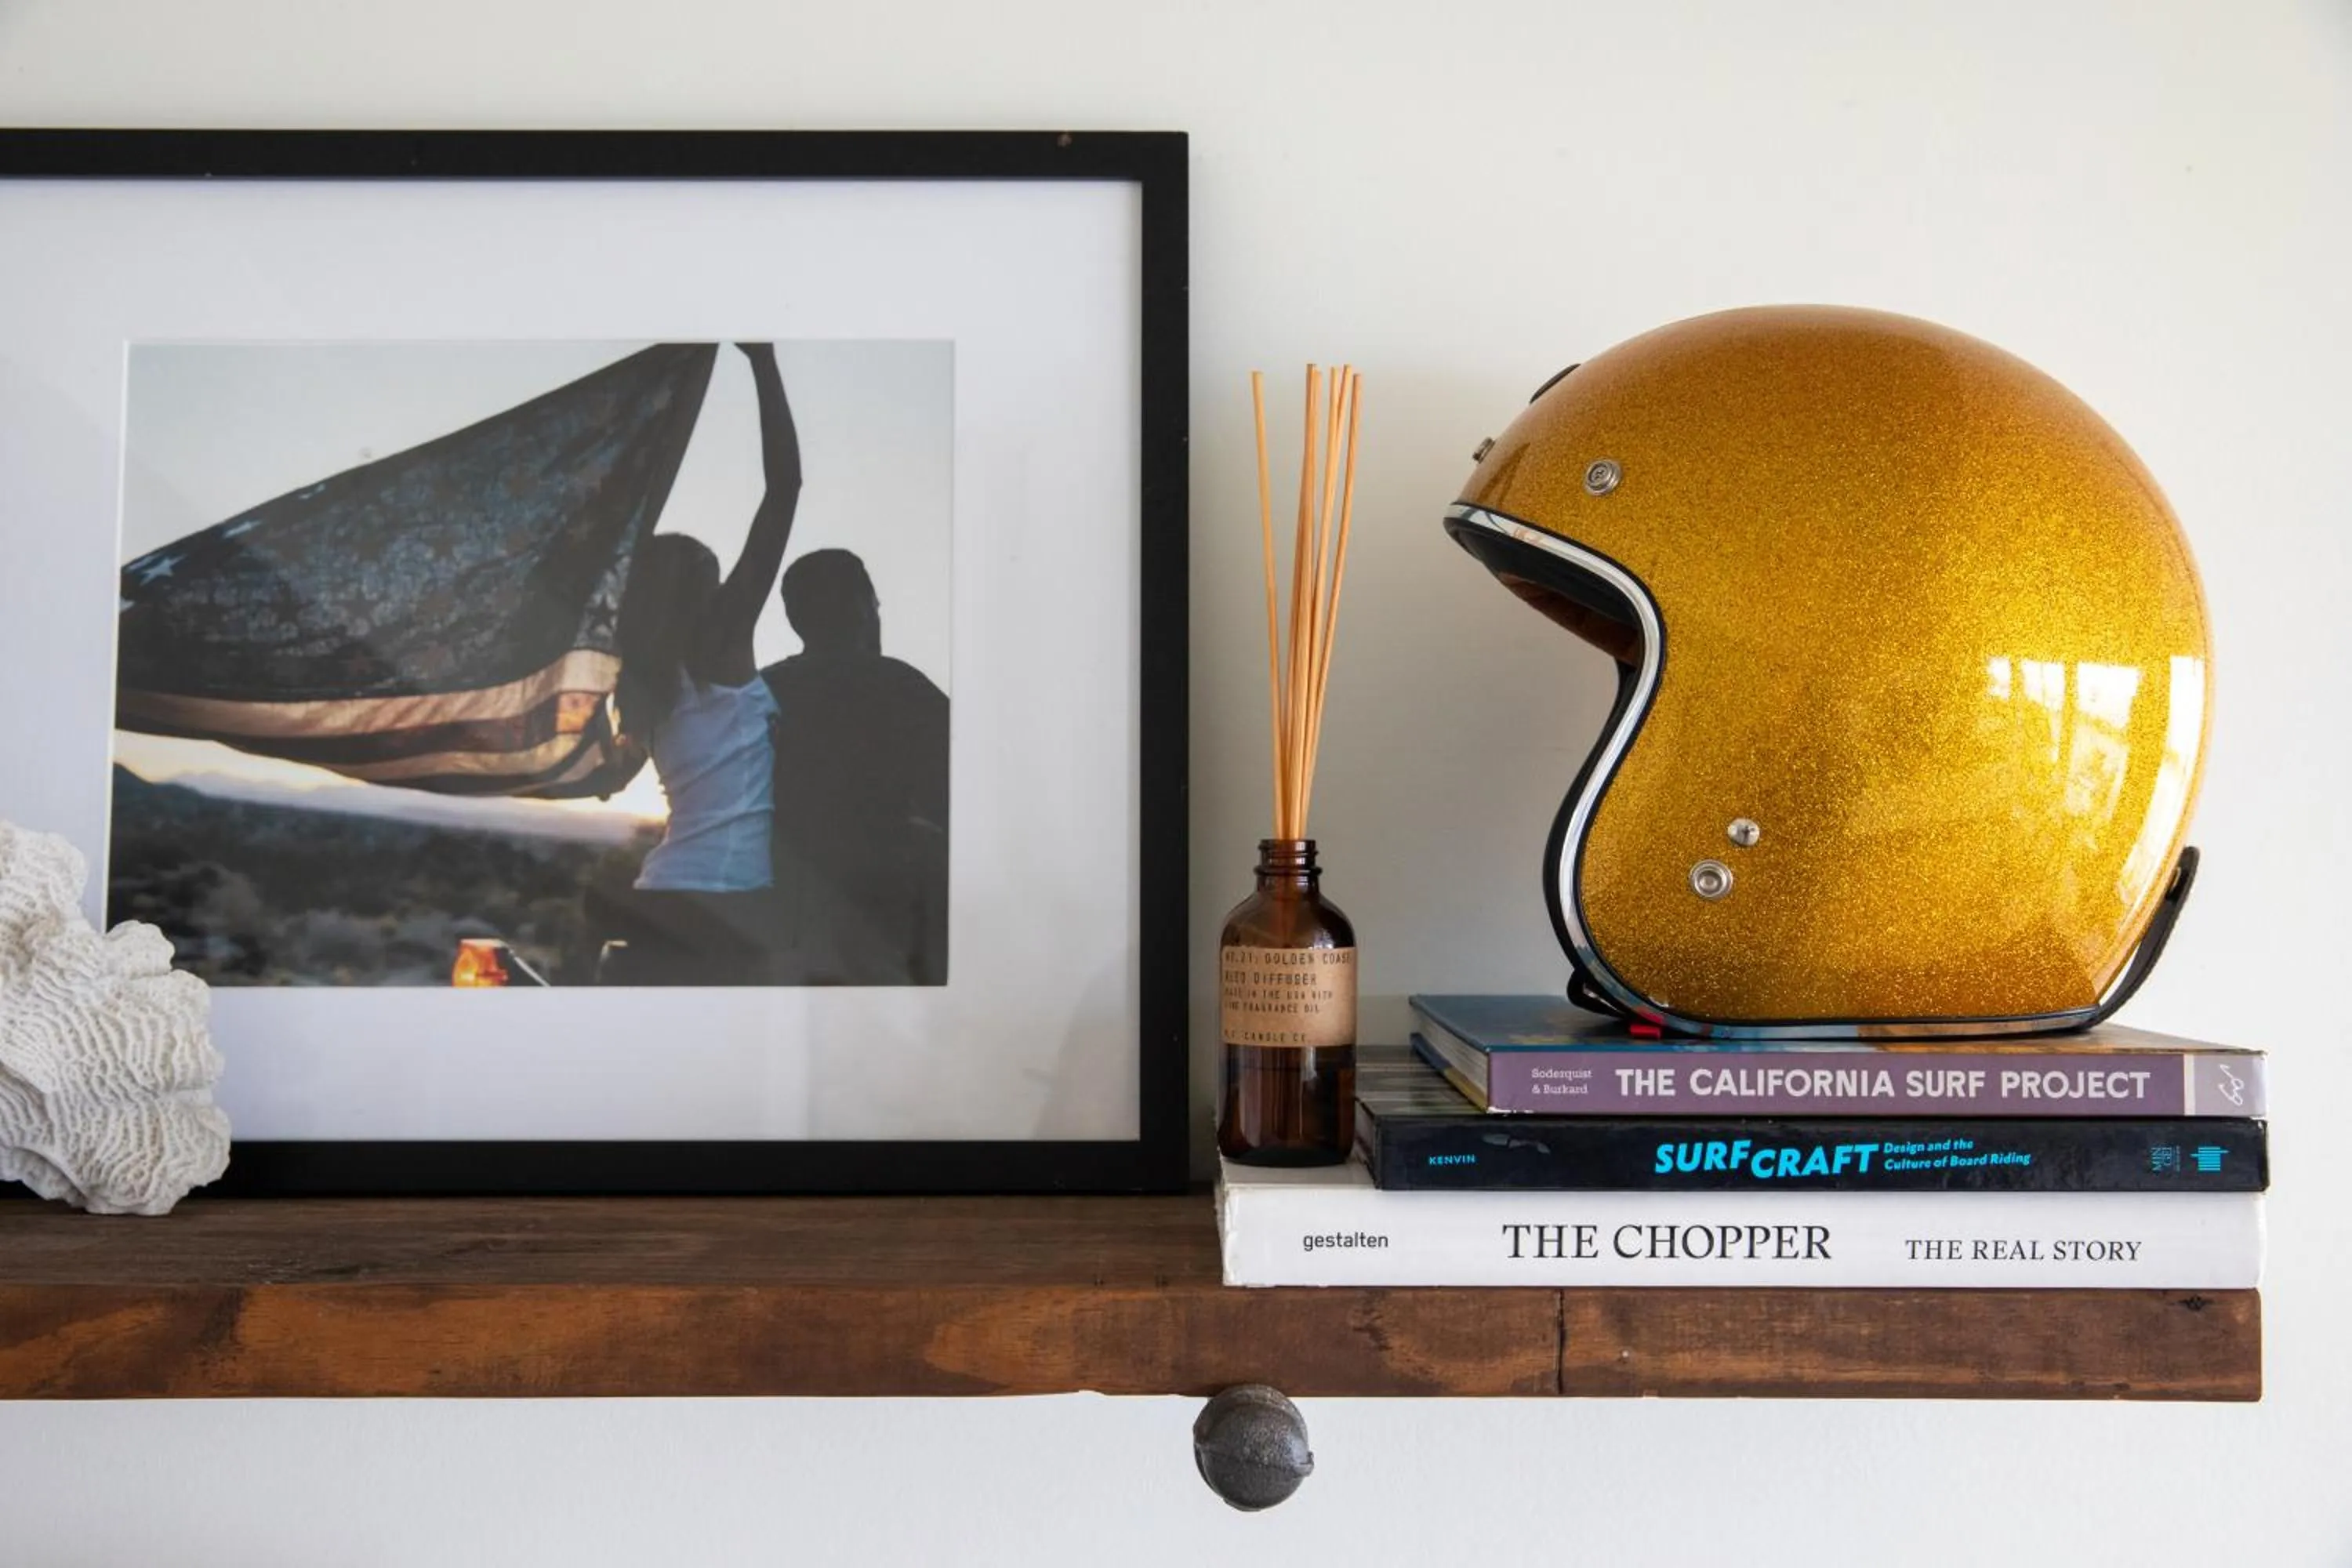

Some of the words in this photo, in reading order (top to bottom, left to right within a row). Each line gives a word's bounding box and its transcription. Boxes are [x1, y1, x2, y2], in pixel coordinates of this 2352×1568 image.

[1265, 953, 1315, 965] GOLDEN
[1254, 972, 1317, 985] DIFFUSER
[1263, 989, 1280, 1000] THE
[1304, 1003, 1320, 1014] OIL
[1531, 1068, 1592, 1081] Soderquist
[1531, 1084, 1541, 1094] &
[1543, 1083, 1588, 1094] Burkard
[1615, 1069, 1676, 1096] THE
[1690, 1068, 1895, 1098] CALIFORNIA
[1906, 1069, 1986, 1098] SURF
[2001, 1070, 2151, 1099] PROJECT
[1883, 1142, 1925, 1155] Design
[1927, 1139, 1951, 1151] and
[1952, 1138, 1974, 1150] the
[1428, 1154, 1475, 1166] KENVIN
[1884, 1159, 1931, 1171] Culture
[1933, 1156, 1949, 1168] of
[1950, 1155, 1987, 1167] Board
[1990, 1152, 2031, 1166] Riding
[1303, 1232, 1388, 1252] gestalten
[1502, 1224, 1599, 1258] THE
[1613, 1224, 1832, 1260] CHOPPER
[1905, 1240, 1962, 1260] THE
[1972, 1240, 2044, 1261] REAL
[2053, 1240, 2142, 1261] STORY
